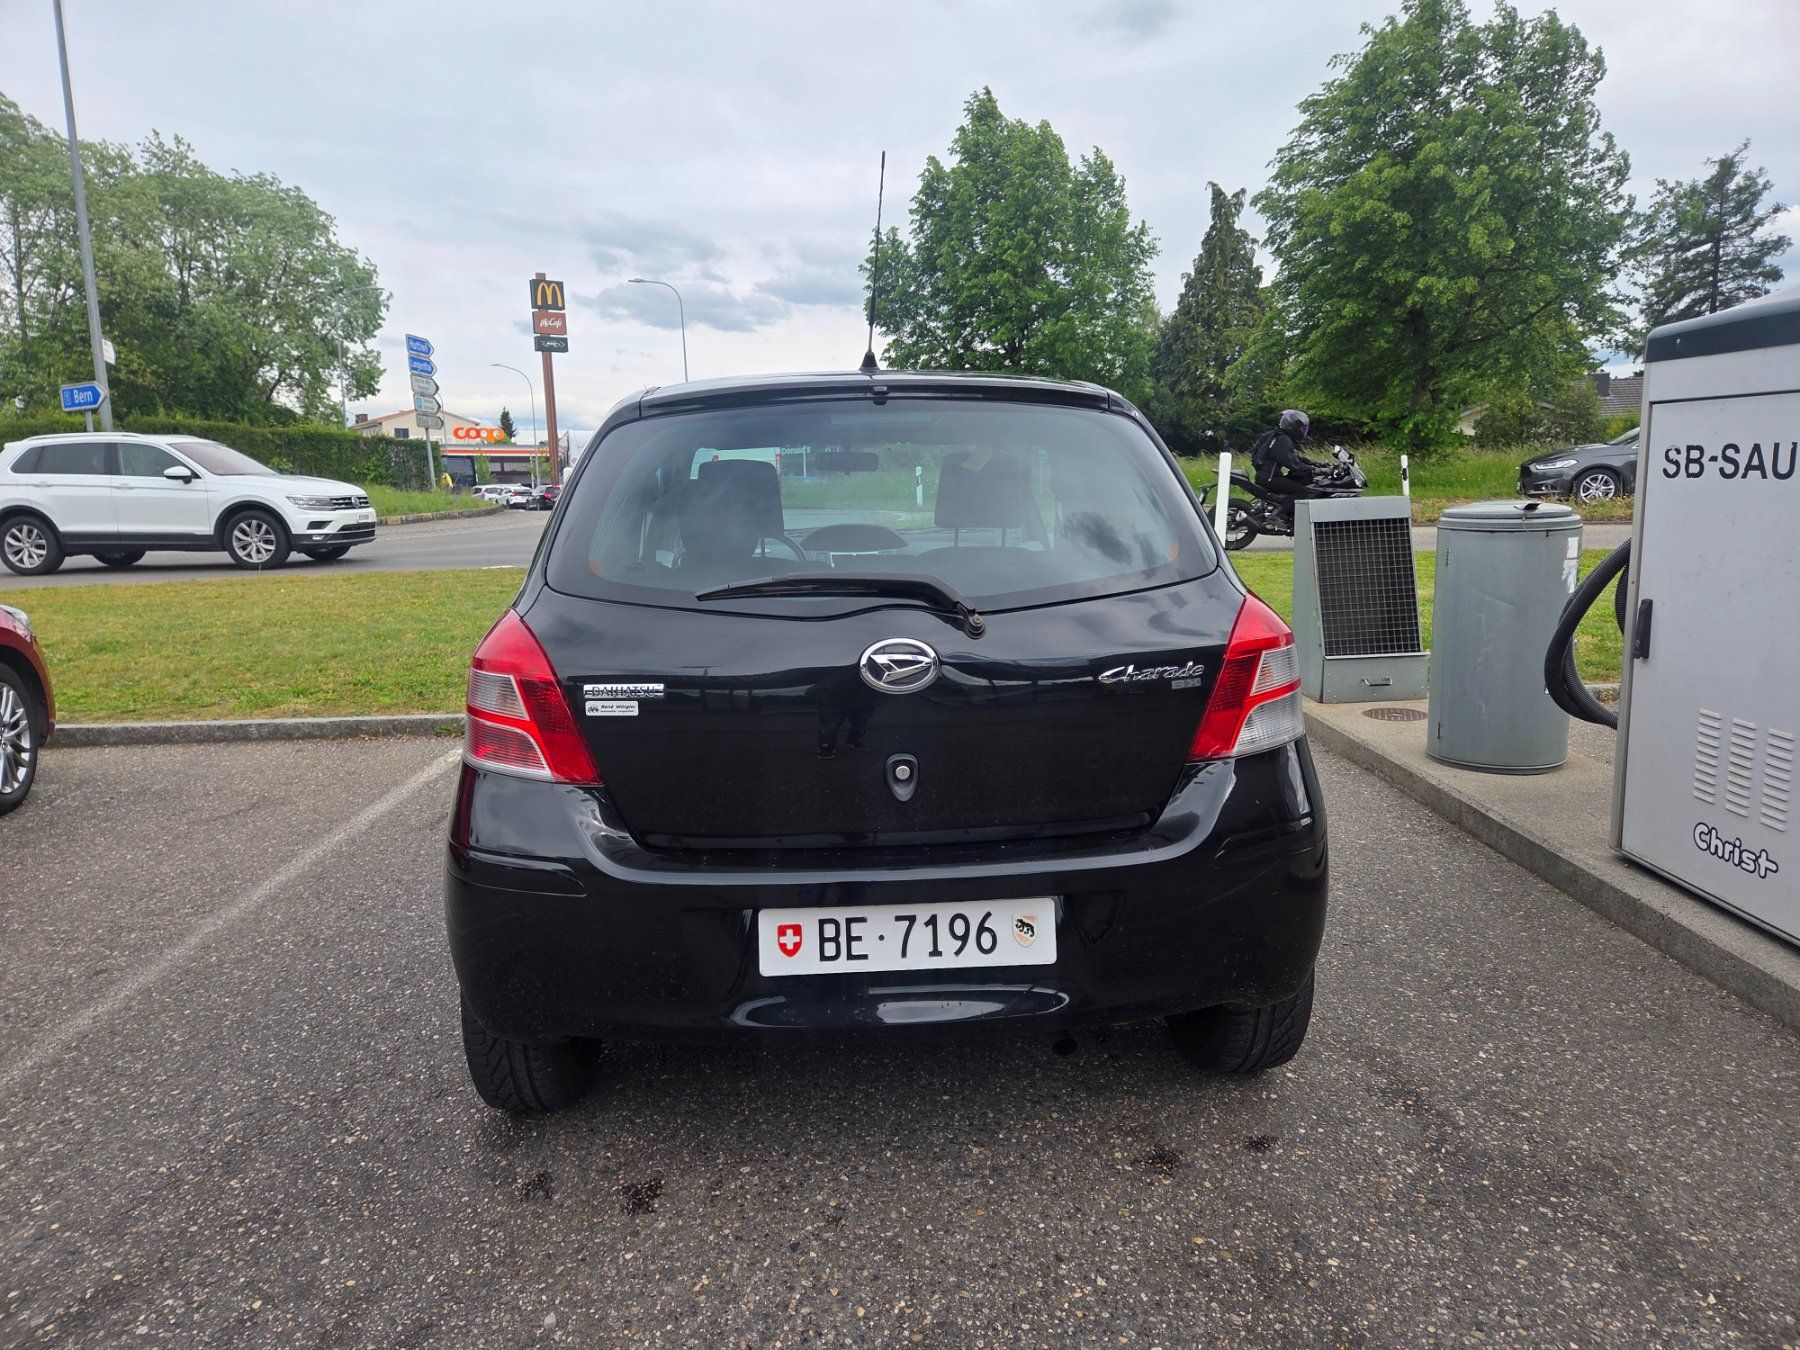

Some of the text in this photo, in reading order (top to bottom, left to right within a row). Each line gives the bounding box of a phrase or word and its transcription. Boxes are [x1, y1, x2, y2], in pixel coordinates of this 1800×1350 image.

[73, 389, 93, 404] Bern
[453, 427, 505, 445] coop
[1662, 441, 1798, 481] SB-SAU
[1098, 661, 1205, 683] Charade
[591, 685, 656, 697] DAIHATSU
[1693, 822, 1779, 879] Christ
